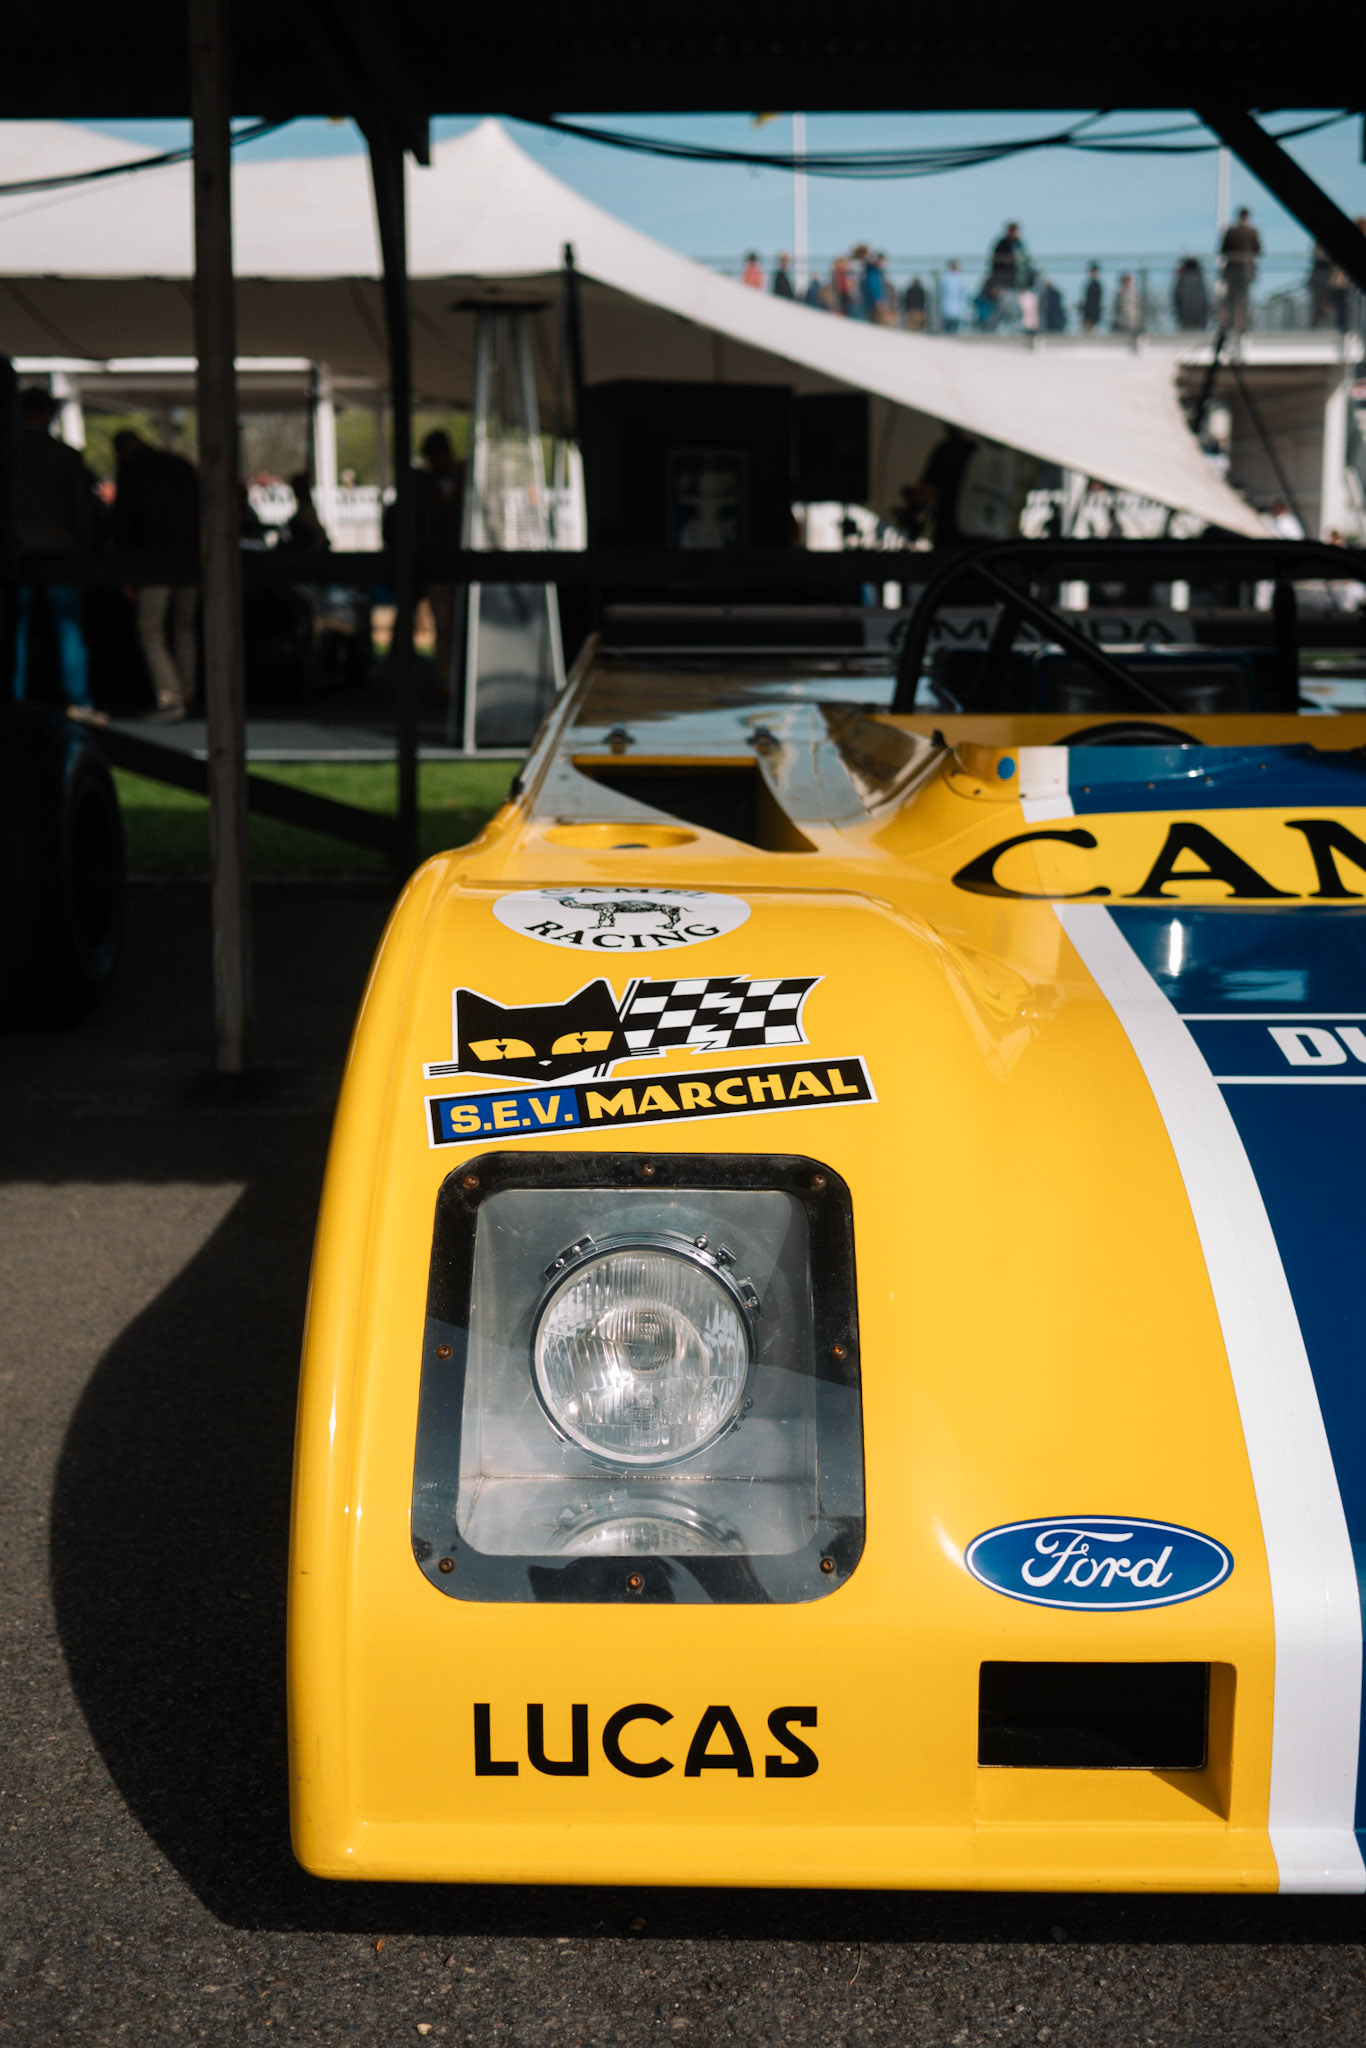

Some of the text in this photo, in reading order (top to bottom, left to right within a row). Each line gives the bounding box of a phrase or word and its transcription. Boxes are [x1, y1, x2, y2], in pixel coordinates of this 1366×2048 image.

[524, 920, 721, 948] RACING
[451, 1068, 859, 1134] S.E.V. MARCHAL
[1021, 1528, 1173, 1587] Ford
[474, 1702, 819, 1778] LUCAS
